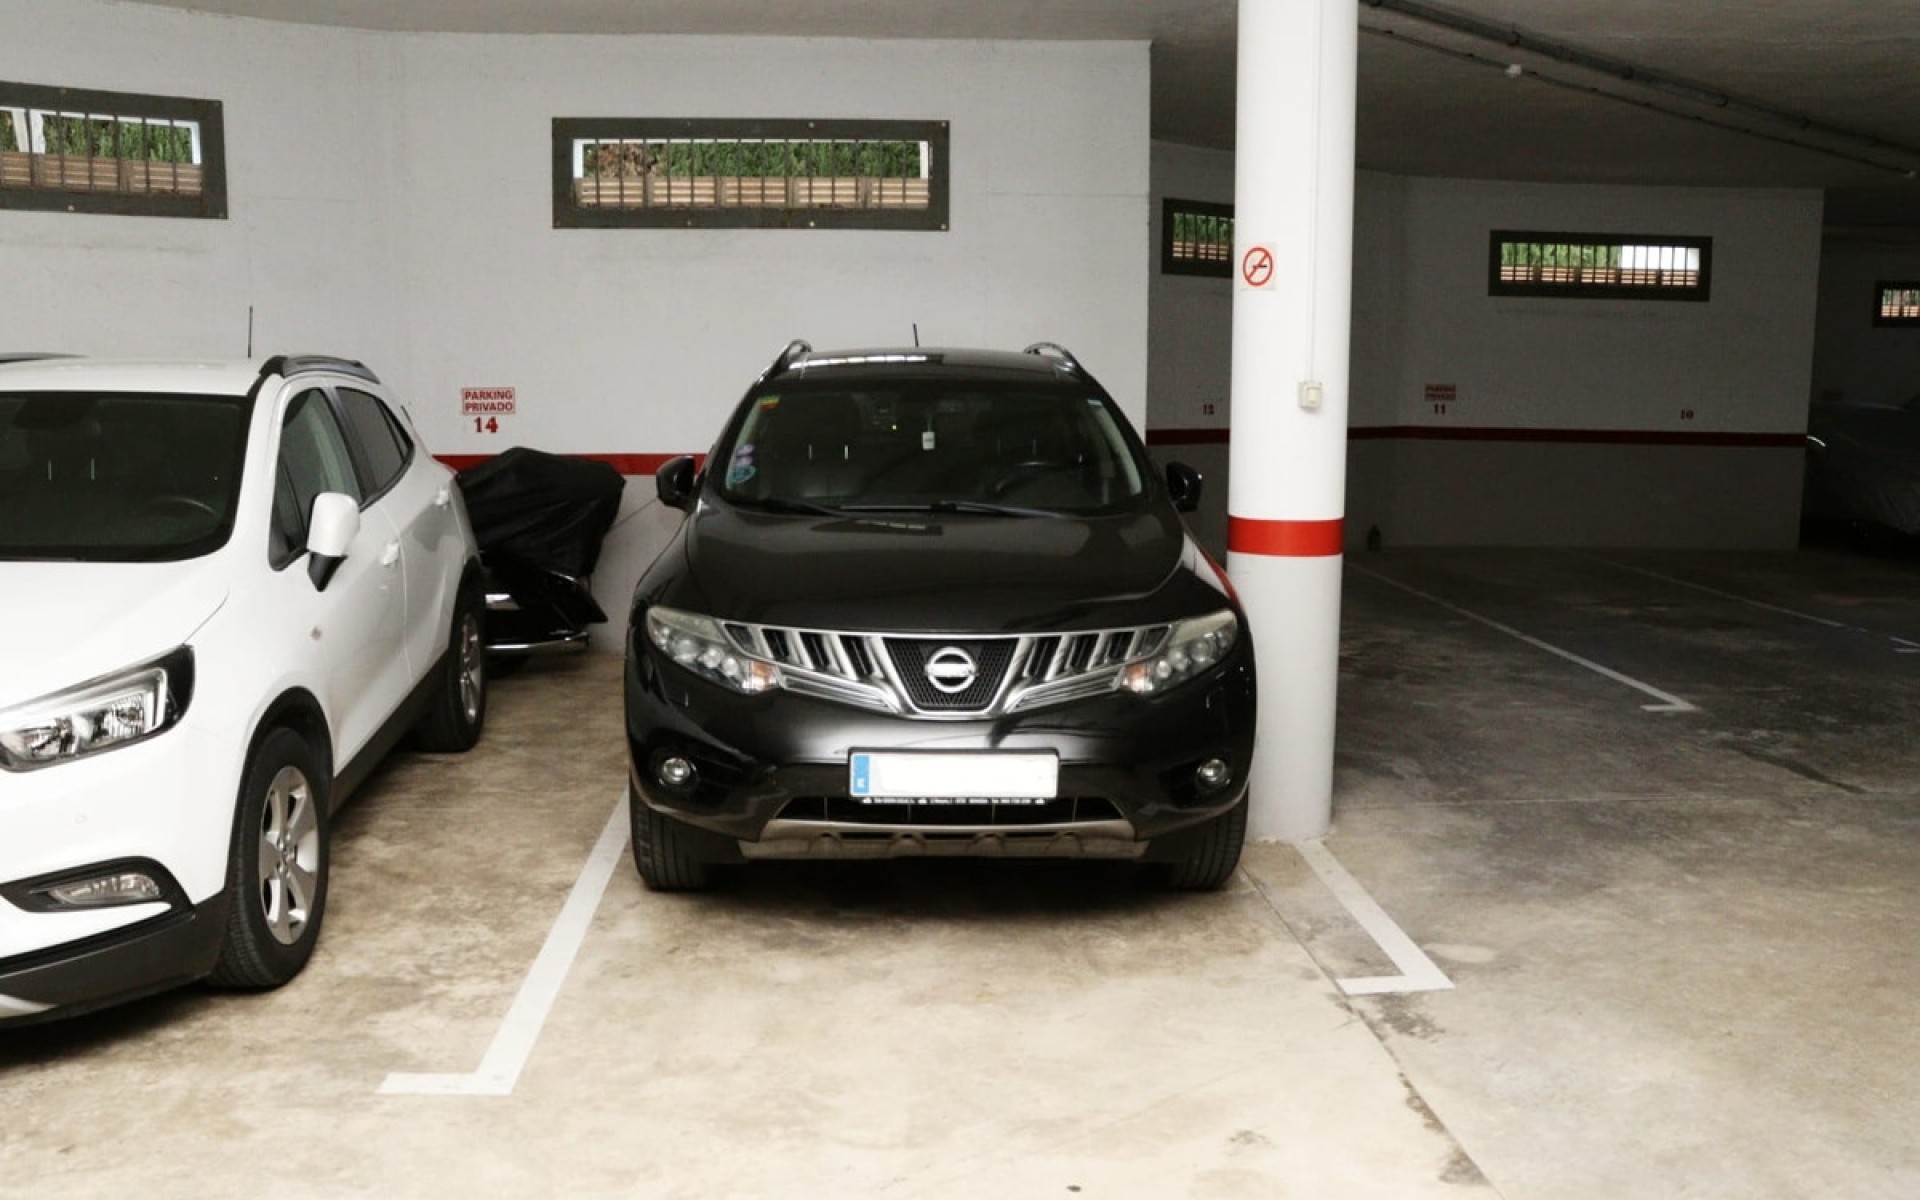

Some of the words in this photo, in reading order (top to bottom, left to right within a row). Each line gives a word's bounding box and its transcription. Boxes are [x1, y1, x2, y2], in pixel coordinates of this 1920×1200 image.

[465, 390, 513, 400] PARKING
[465, 402, 513, 412] PRIVADO
[474, 416, 499, 433] 14
